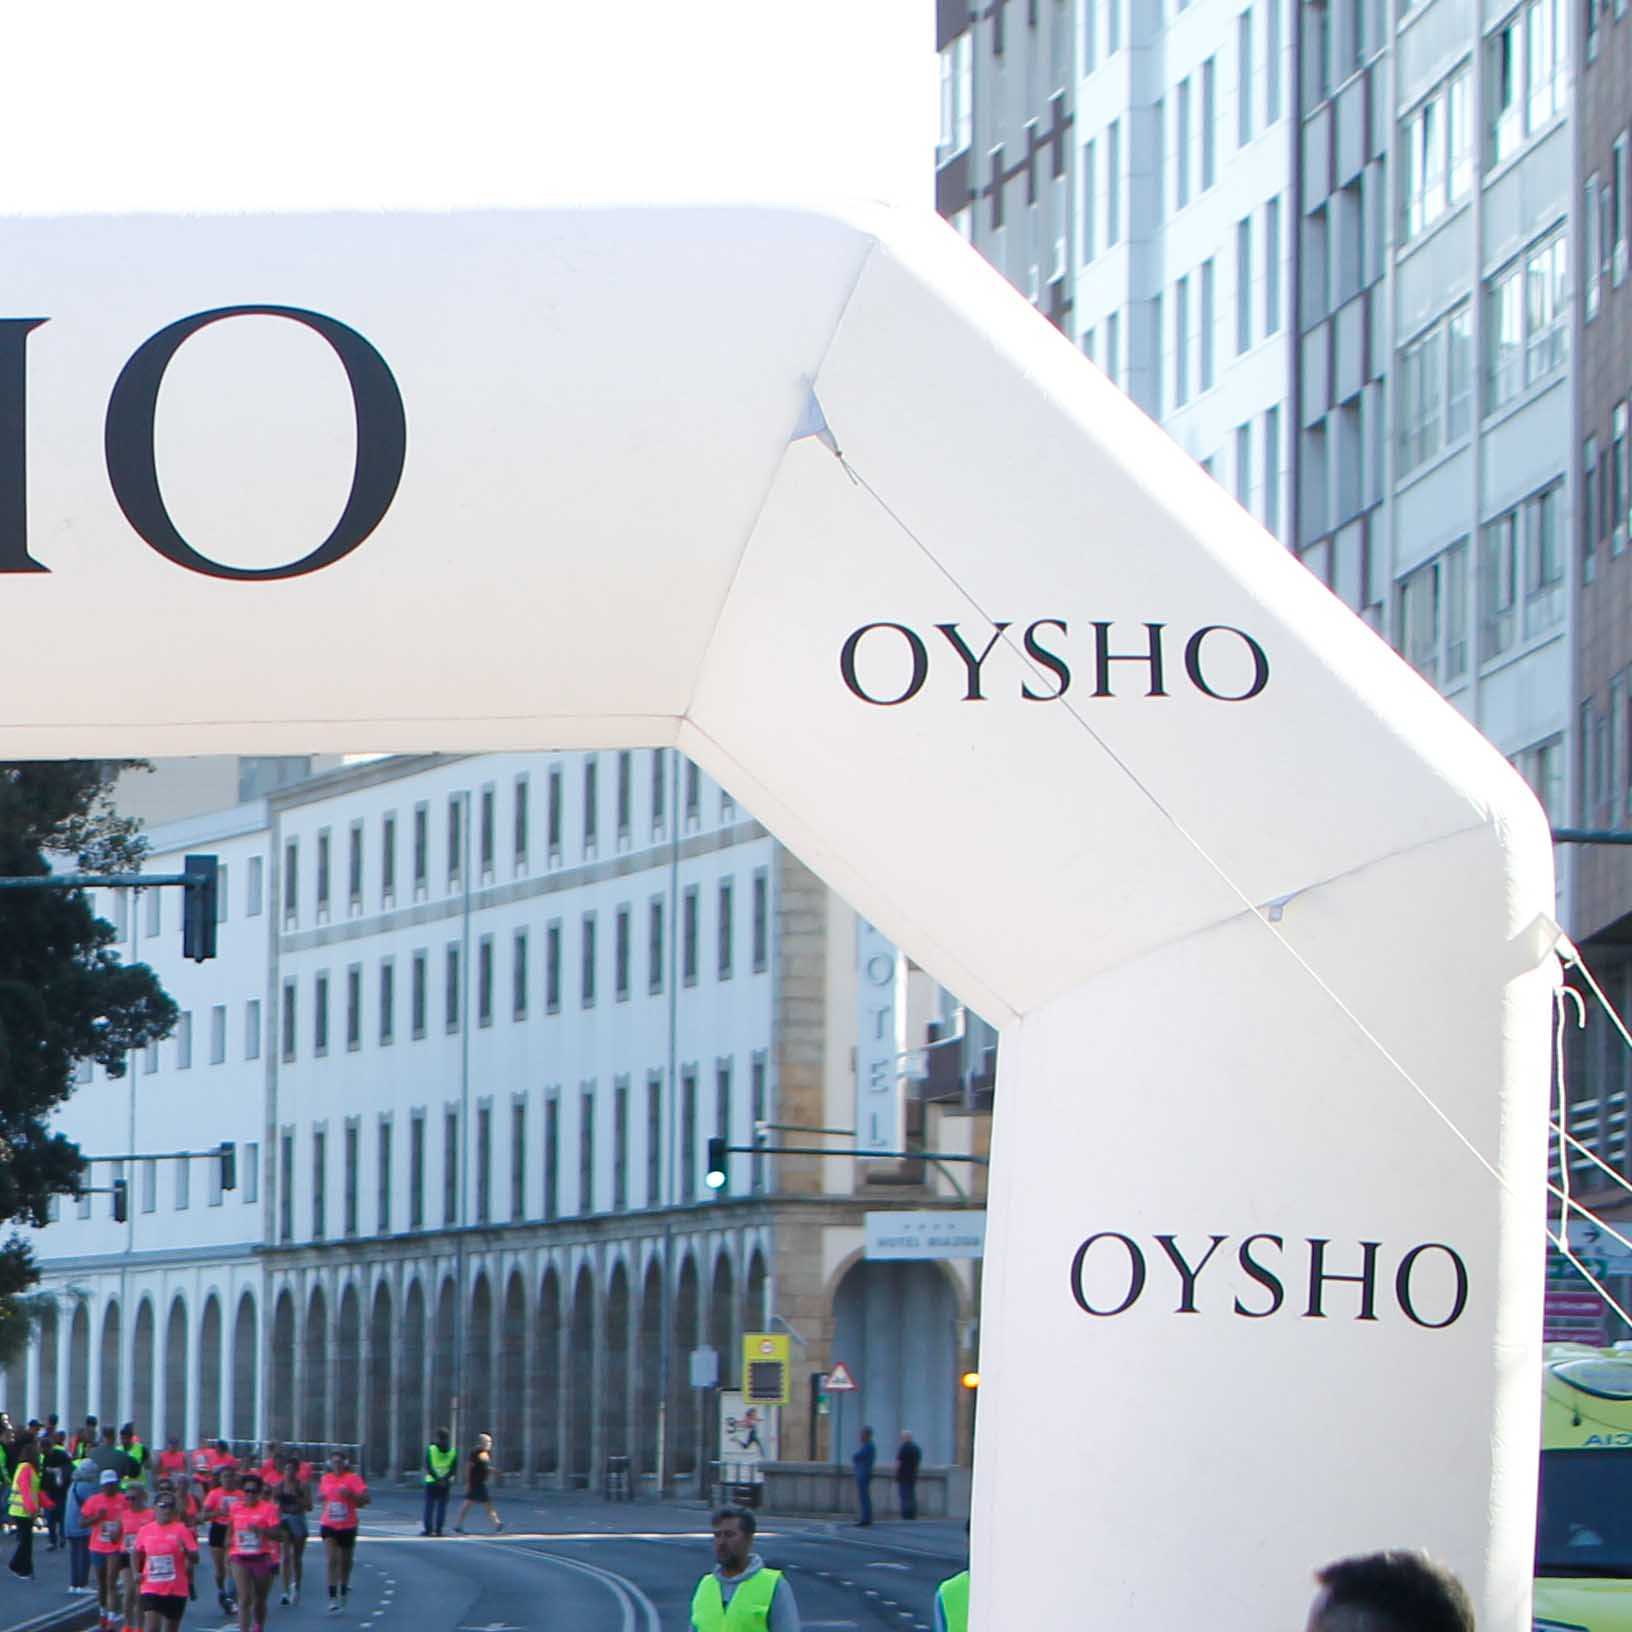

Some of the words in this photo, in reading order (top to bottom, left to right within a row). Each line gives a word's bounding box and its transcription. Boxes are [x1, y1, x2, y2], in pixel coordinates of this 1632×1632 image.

[841, 619, 1270, 706] OYSHO
[866, 926, 894, 1147] OTEL
[1070, 1232, 1469, 1329] OYSHO
